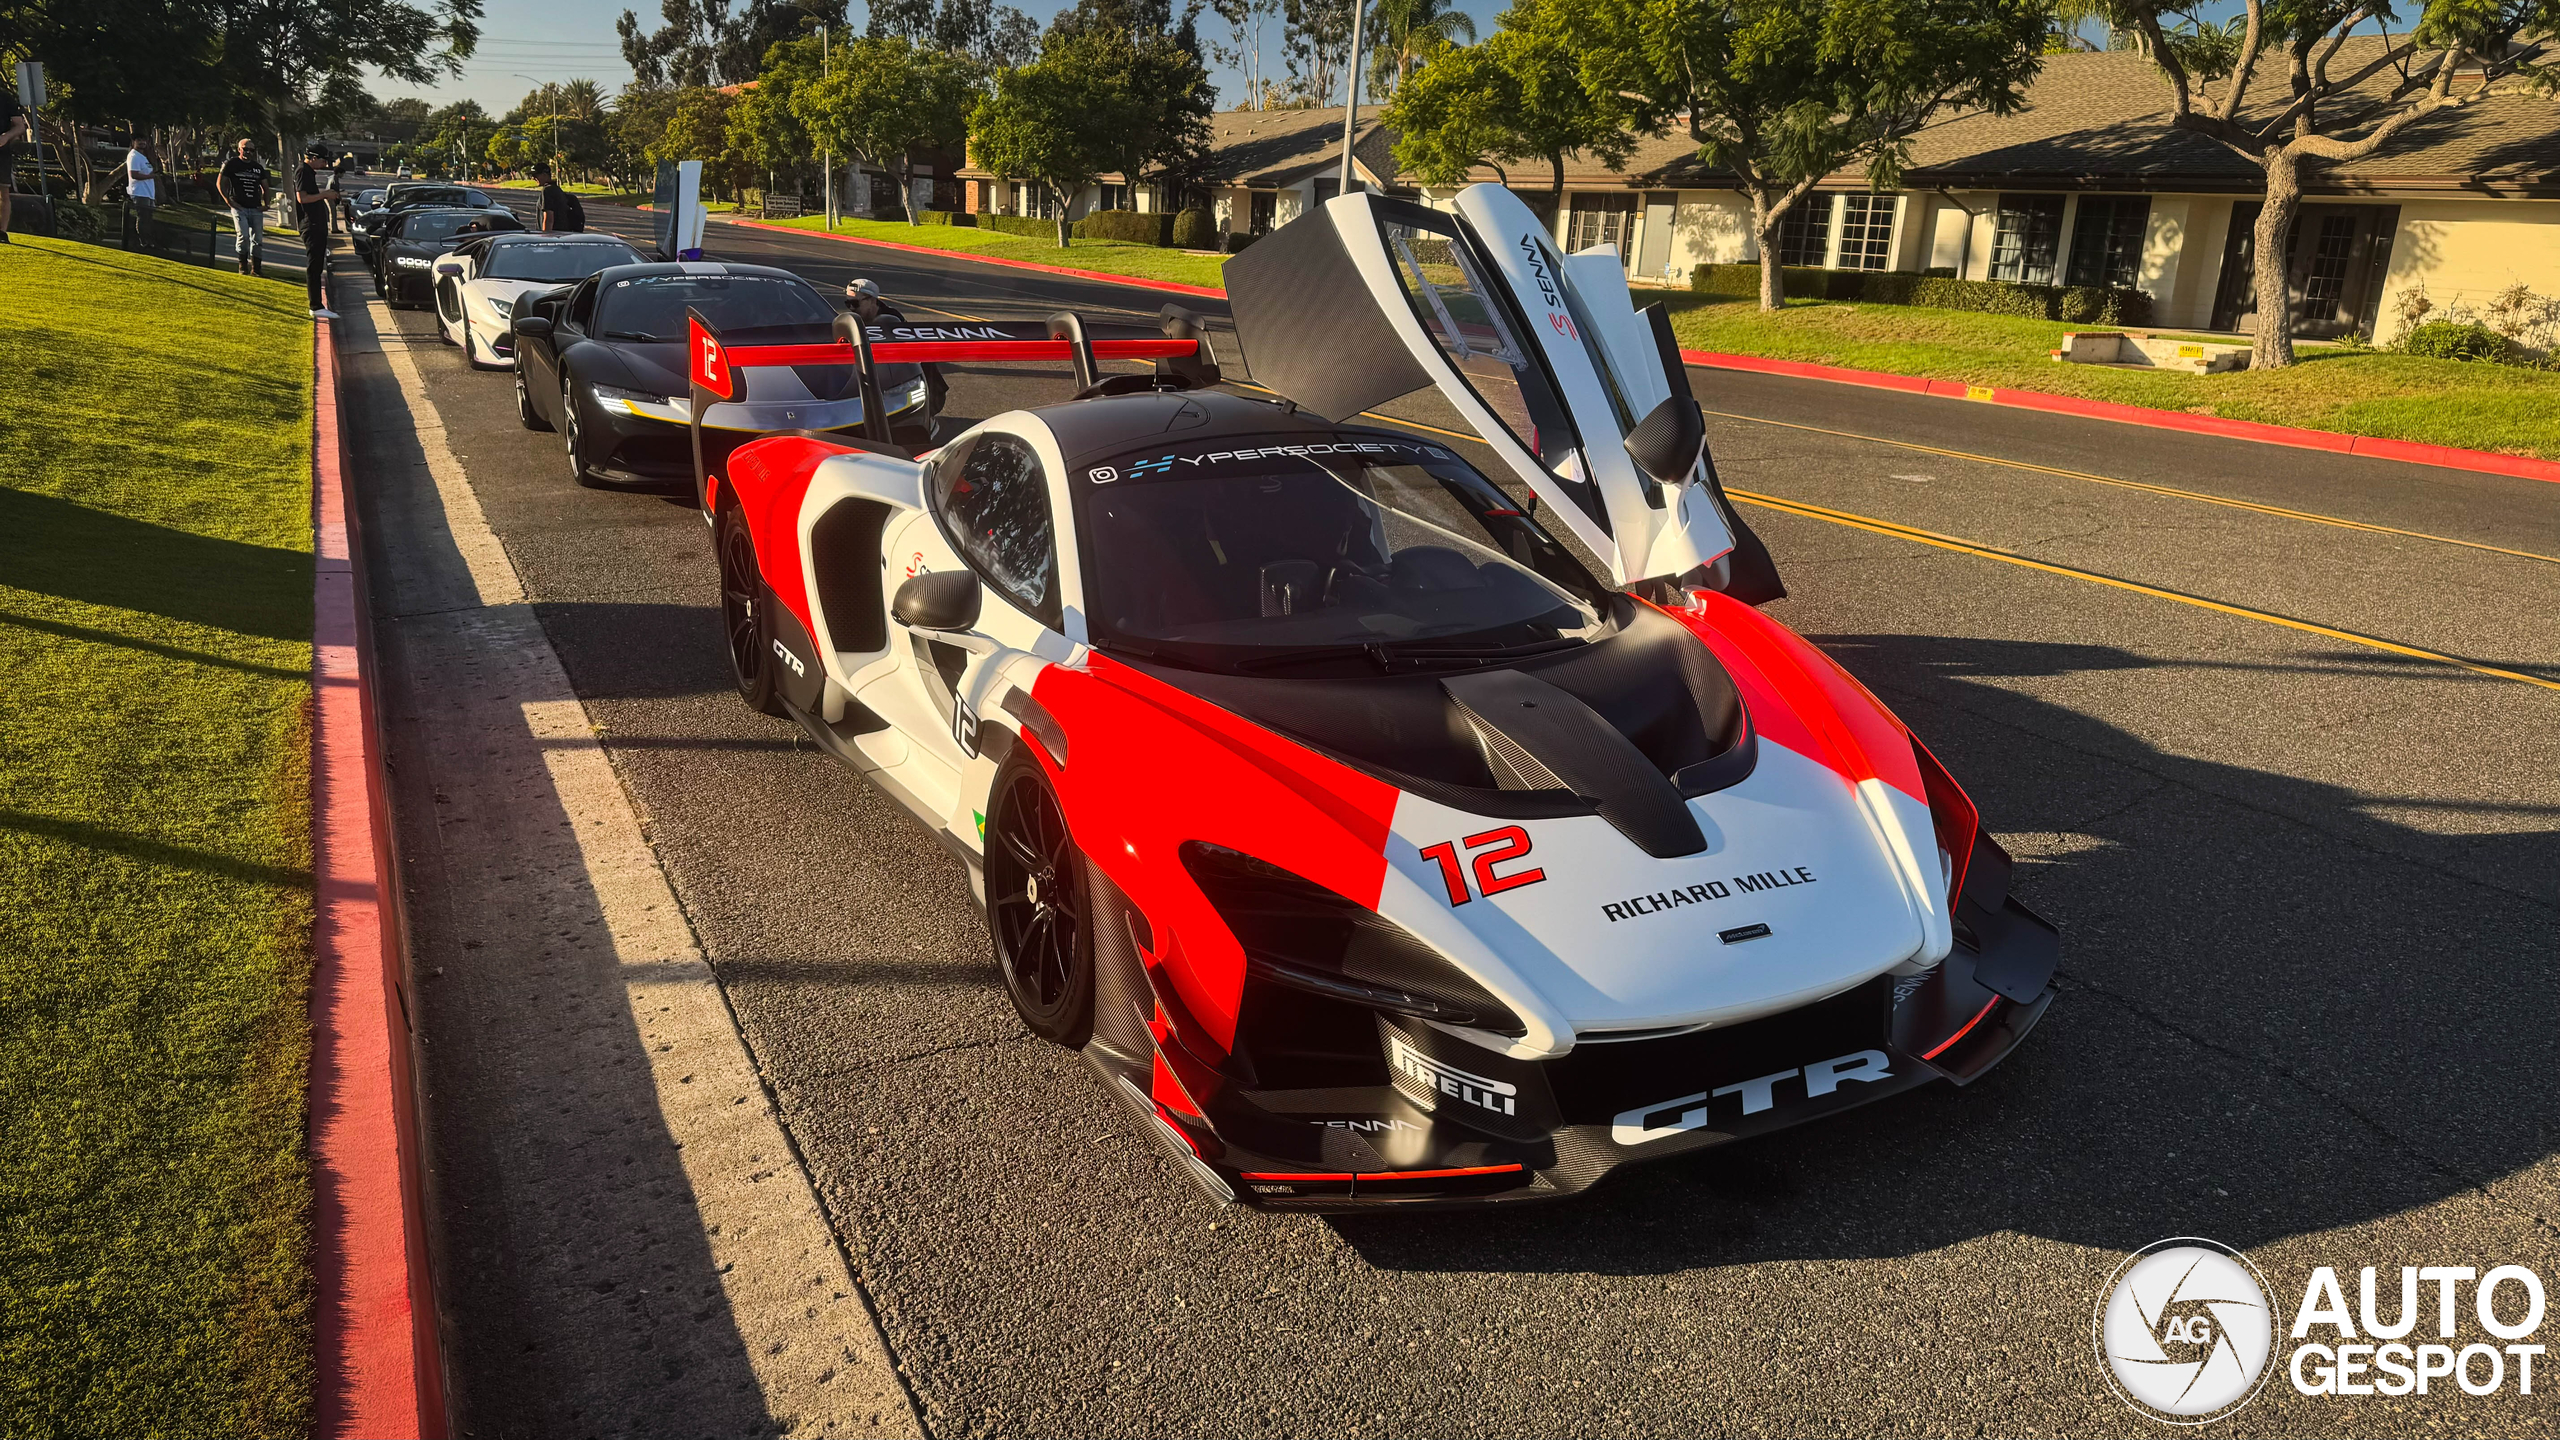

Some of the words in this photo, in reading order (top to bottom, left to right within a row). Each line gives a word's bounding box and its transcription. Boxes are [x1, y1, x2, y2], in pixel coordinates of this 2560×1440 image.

[1519, 232, 1562, 309] SENNA
[702, 335, 718, 383] 12
[892, 326, 1017, 340] SENNA
[772, 637, 806, 679] GTR
[954, 691, 978, 759] 12
[1418, 824, 1548, 908] 12
[1601, 880, 1732, 923] RICHARD
[1733, 866, 1818, 894] MILLE
[1391, 1036, 1518, 1117] PIRELLI
[1611, 1049, 1896, 1146] GTR
